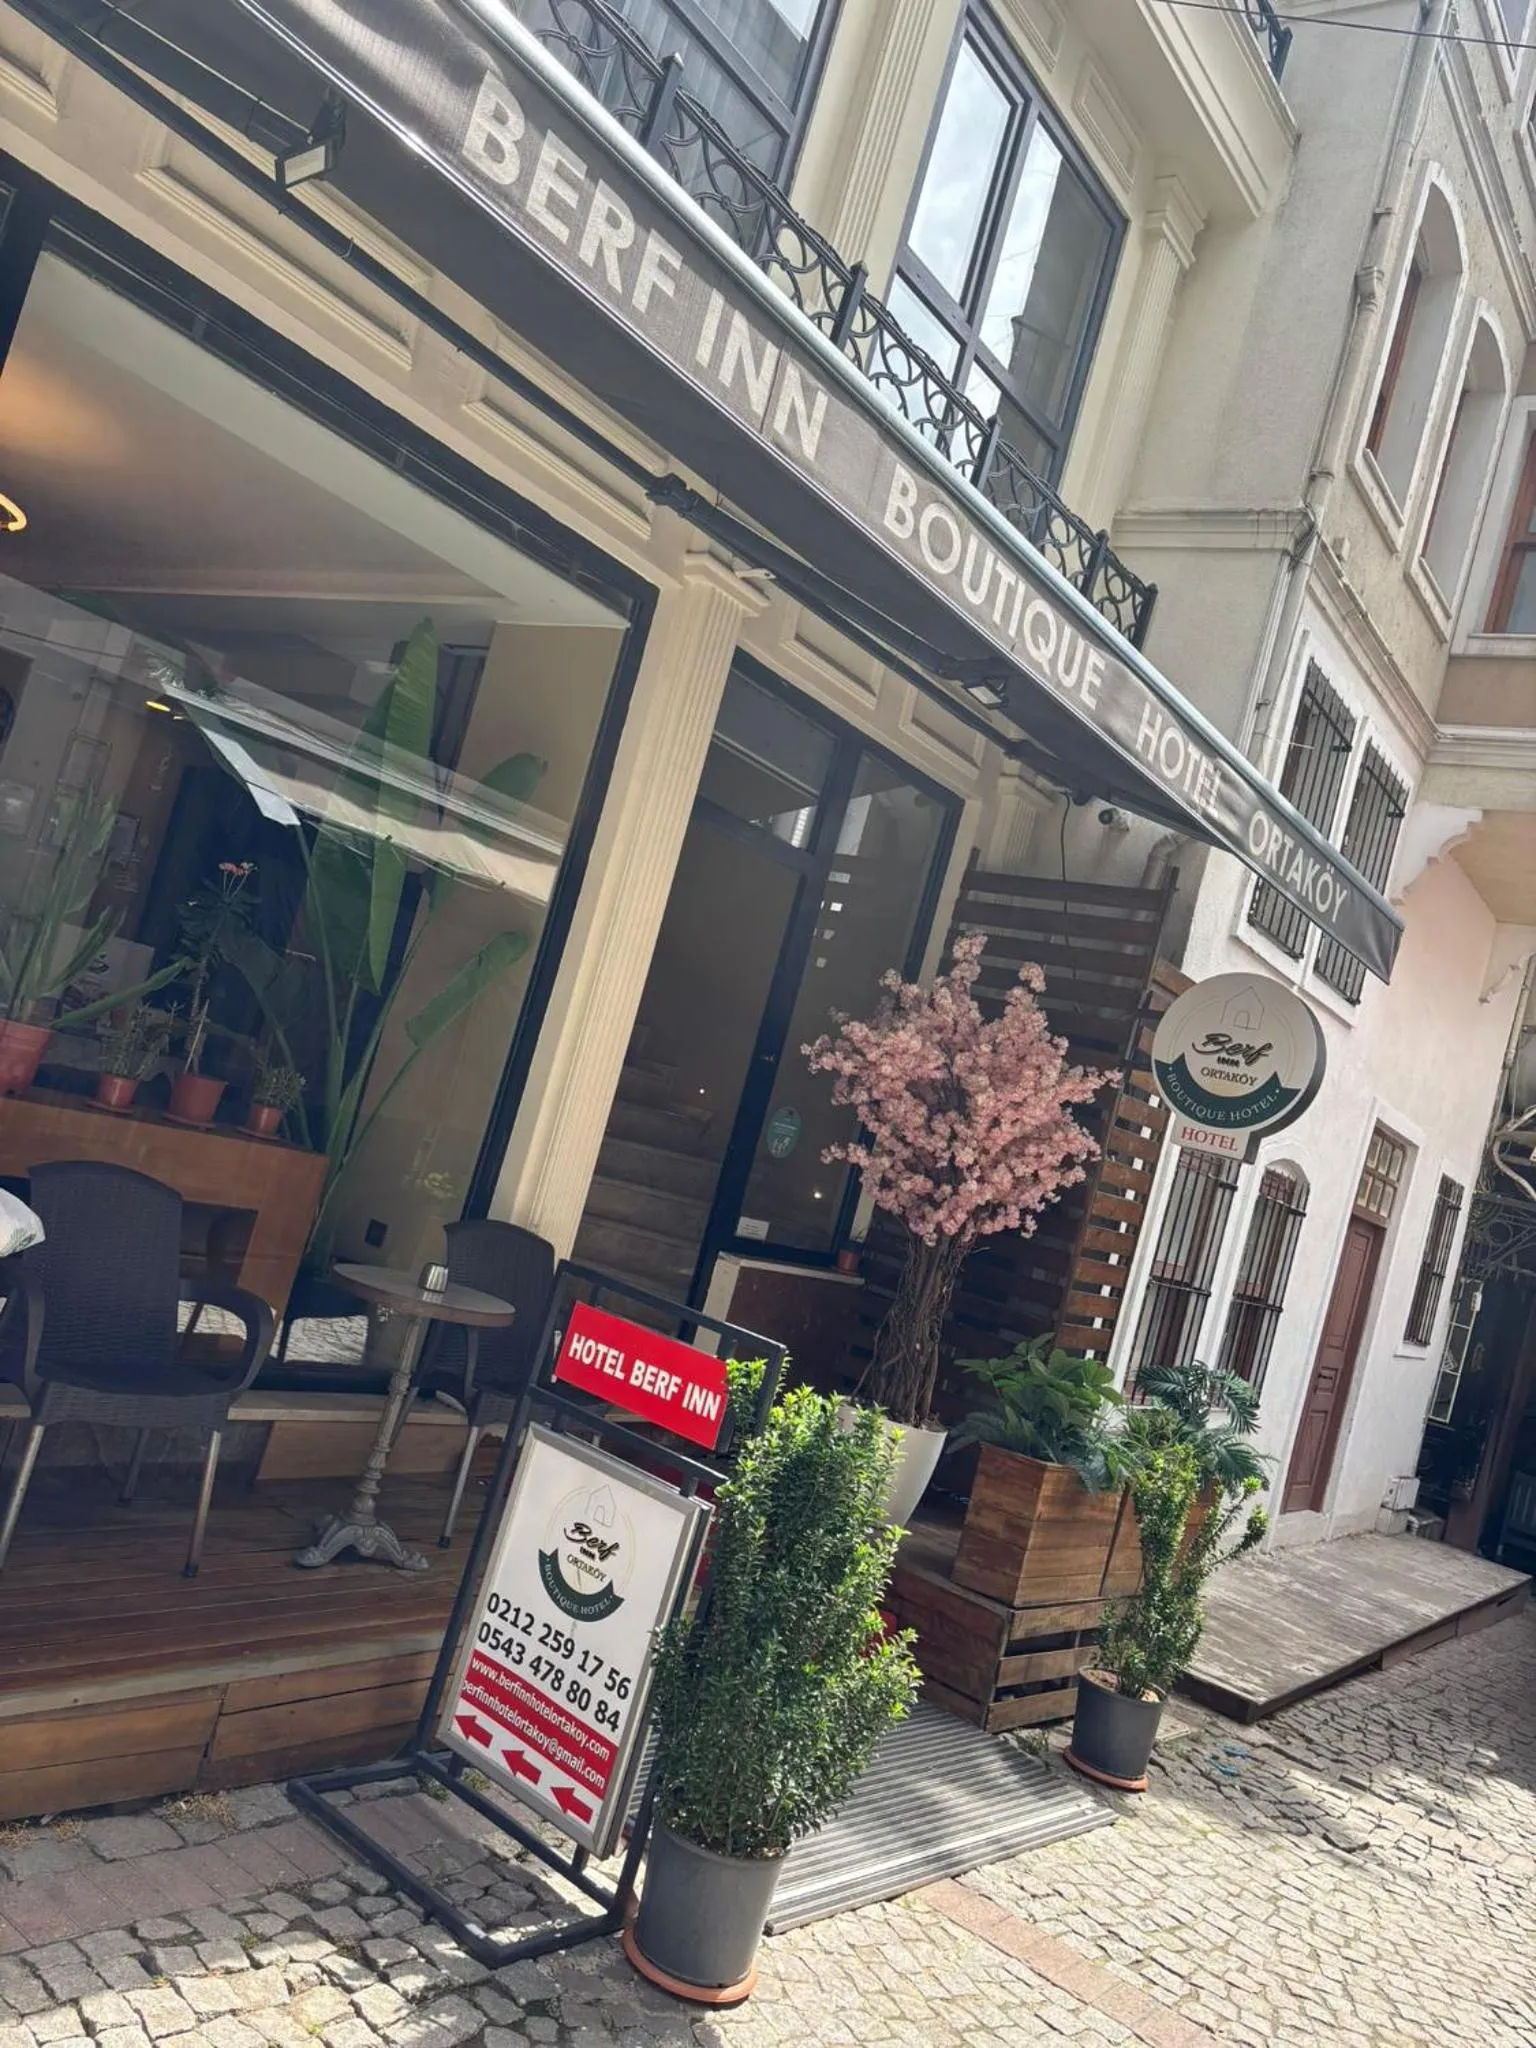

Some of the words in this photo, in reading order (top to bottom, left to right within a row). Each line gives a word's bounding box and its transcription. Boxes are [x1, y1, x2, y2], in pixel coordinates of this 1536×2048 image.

[461, 69, 684, 315] BERF
[694, 287, 829, 463] INN
[882, 462, 1108, 712] BOUTIQUE
[1134, 701, 1223, 819] HOTEL
[1247, 810, 1348, 924] ORTAKÖY
[1191, 1033, 1274, 1066] Berf
[1166, 1072, 1226, 1122] BOUTIQUE
[1229, 1093, 1277, 1122] HOTEL
[1181, 1126, 1238, 1152] HOTEL
[567, 1332, 626, 1381] HOTEL
[629, 1359, 683, 1402] BERF
[682, 1382, 721, 1421] INN
[563, 1521, 620, 1562] Berf
[543, 1563, 579, 1614] BOUTIQUE
[579, 1596, 612, 1615] HOTEL
[478, 1621, 526, 1665] 0543
[529, 1655, 565, 1692] 478
[566, 1680, 591, 1711] 80
[594, 1699, 621, 1733] 84
[487, 1592, 535, 1636] 0212
[538, 1622, 576, 1660] 259
[577, 1649, 604, 1678] 17
[604, 1667, 631, 1700] 56
[471, 1657, 610, 1761] www.berfinnhotelortakoy.com
